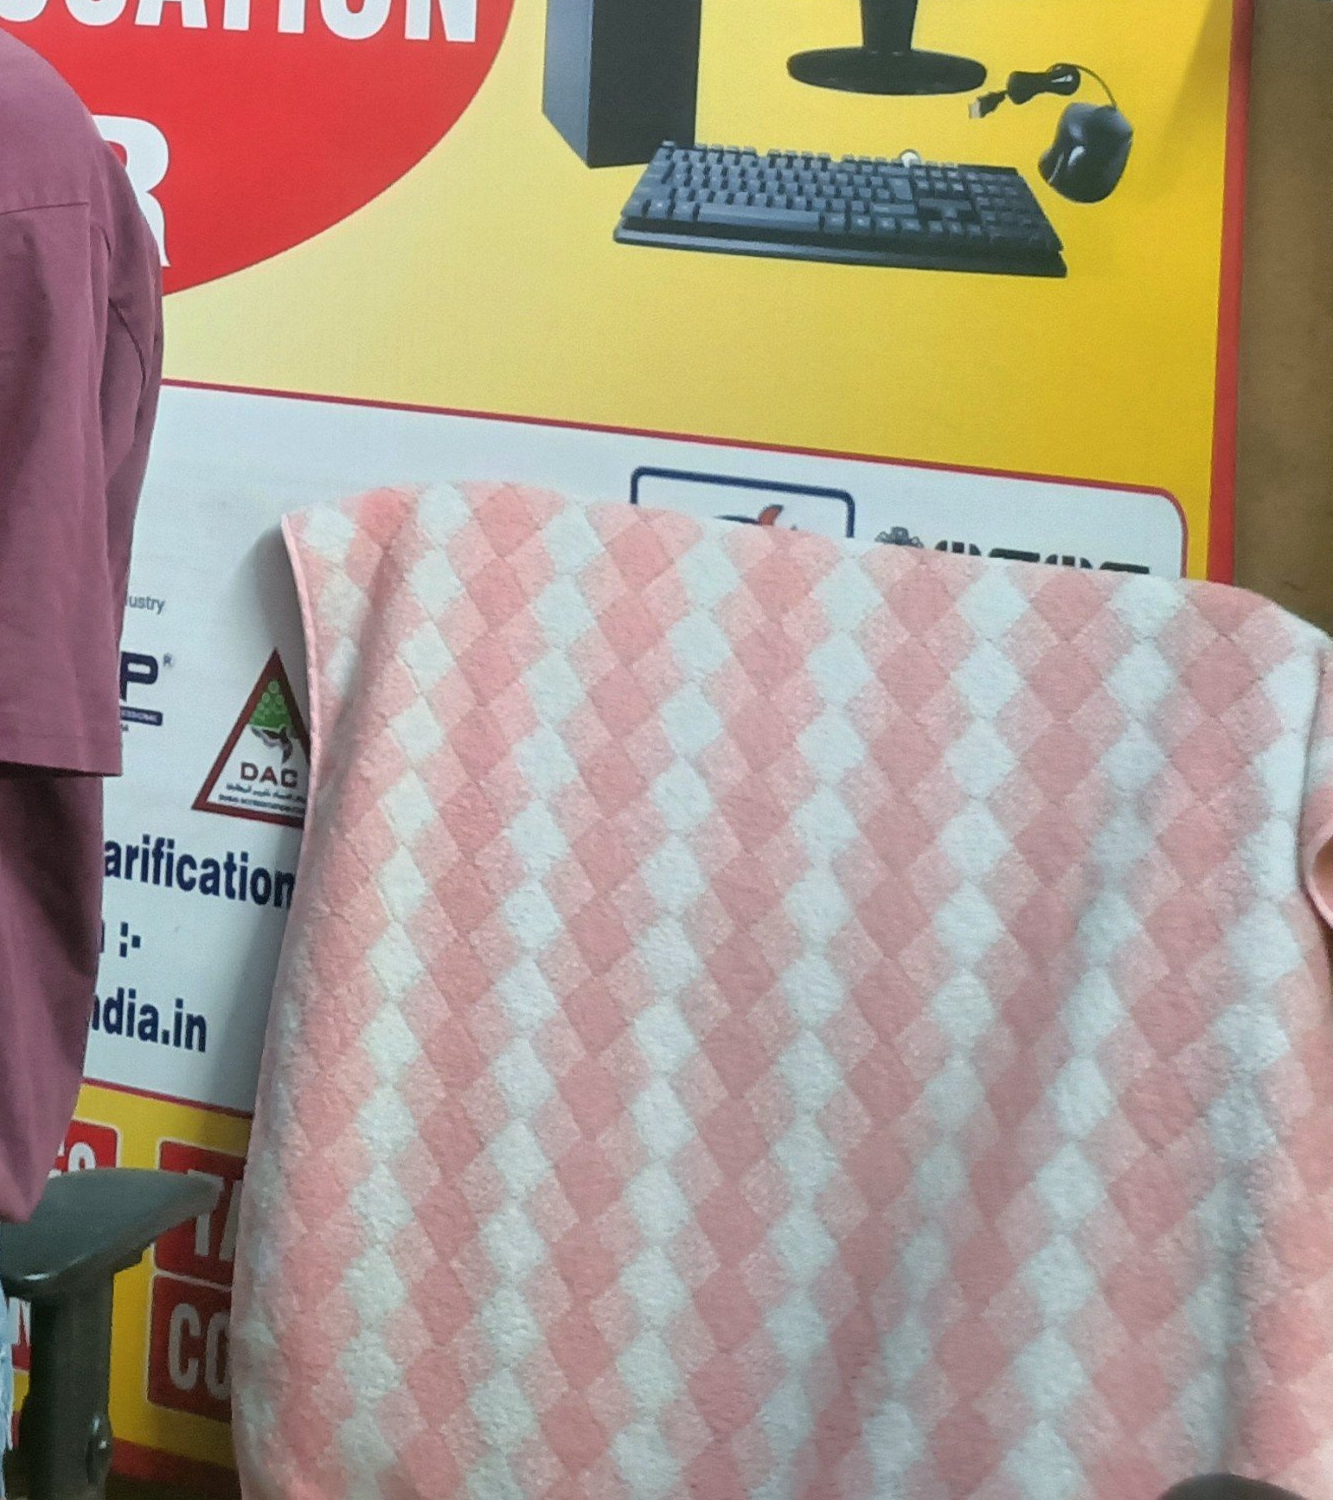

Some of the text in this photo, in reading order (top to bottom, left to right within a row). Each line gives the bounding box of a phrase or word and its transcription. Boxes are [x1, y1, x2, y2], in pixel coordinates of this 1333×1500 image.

[128, 596, 165, 615] ustry
[240, 762, 298, 788] DAC
[103, 835, 296, 911] arification
[87, 986, 207, 1054] dia.in
